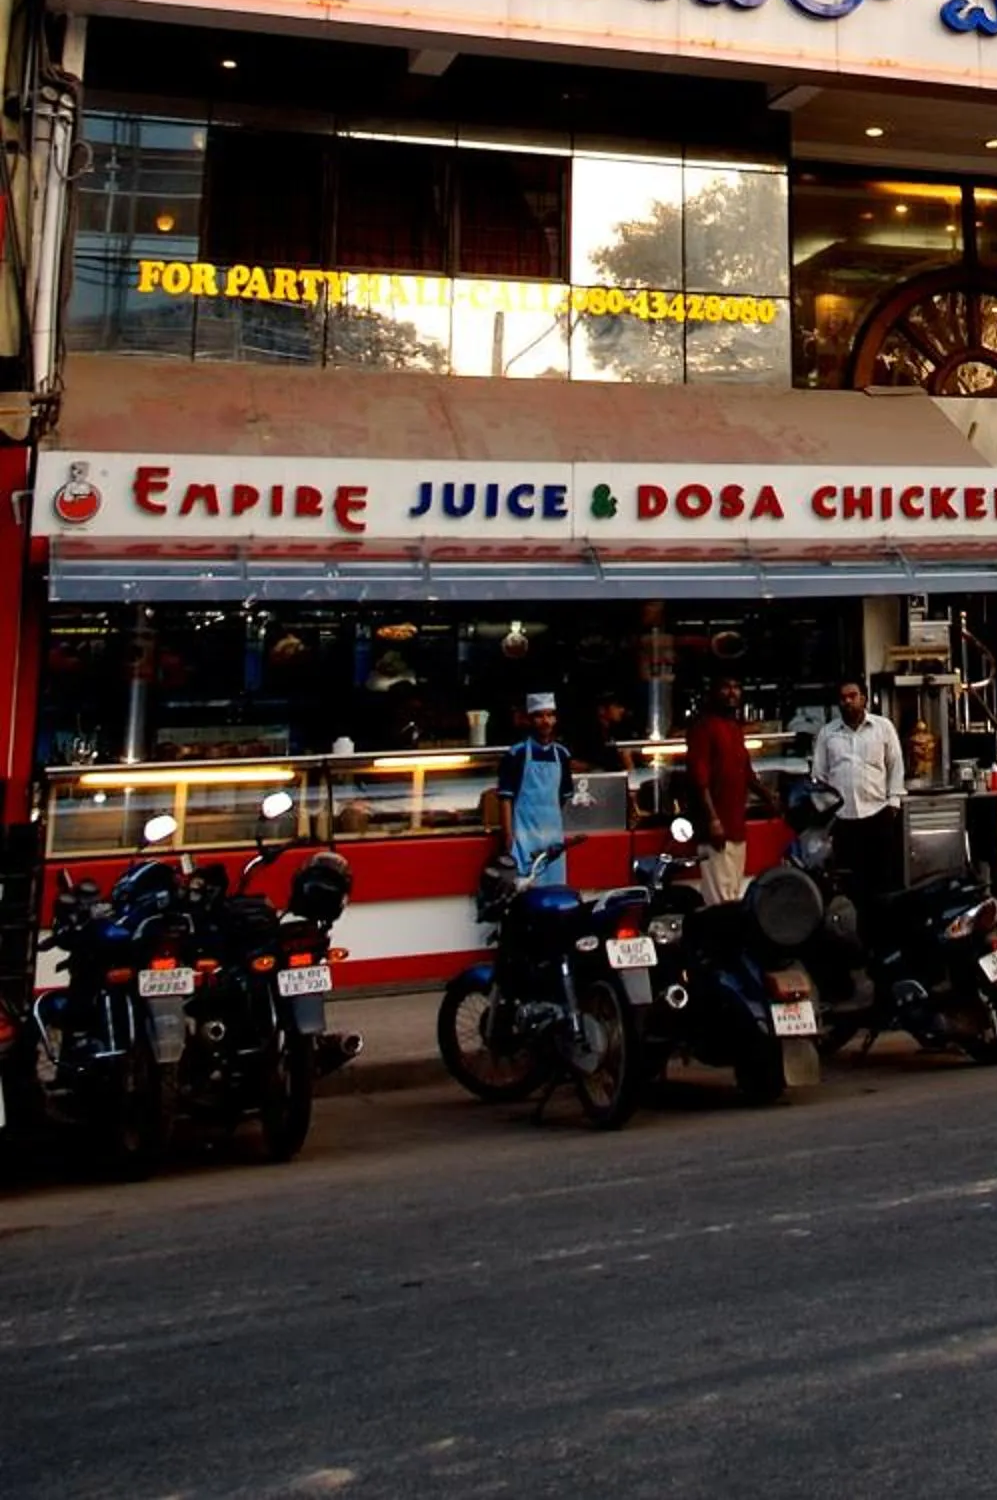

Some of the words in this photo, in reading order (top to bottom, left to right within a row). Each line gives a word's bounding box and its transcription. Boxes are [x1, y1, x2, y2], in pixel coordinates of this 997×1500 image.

[137, 261, 217, 296] FOR
[225, 265, 350, 304] PARTY
[133, 466, 369, 534] EMPIRE
[408, 481, 569, 520] JUICE
[590, 483, 619, 519] &
[637, 484, 785, 520] DOSA
